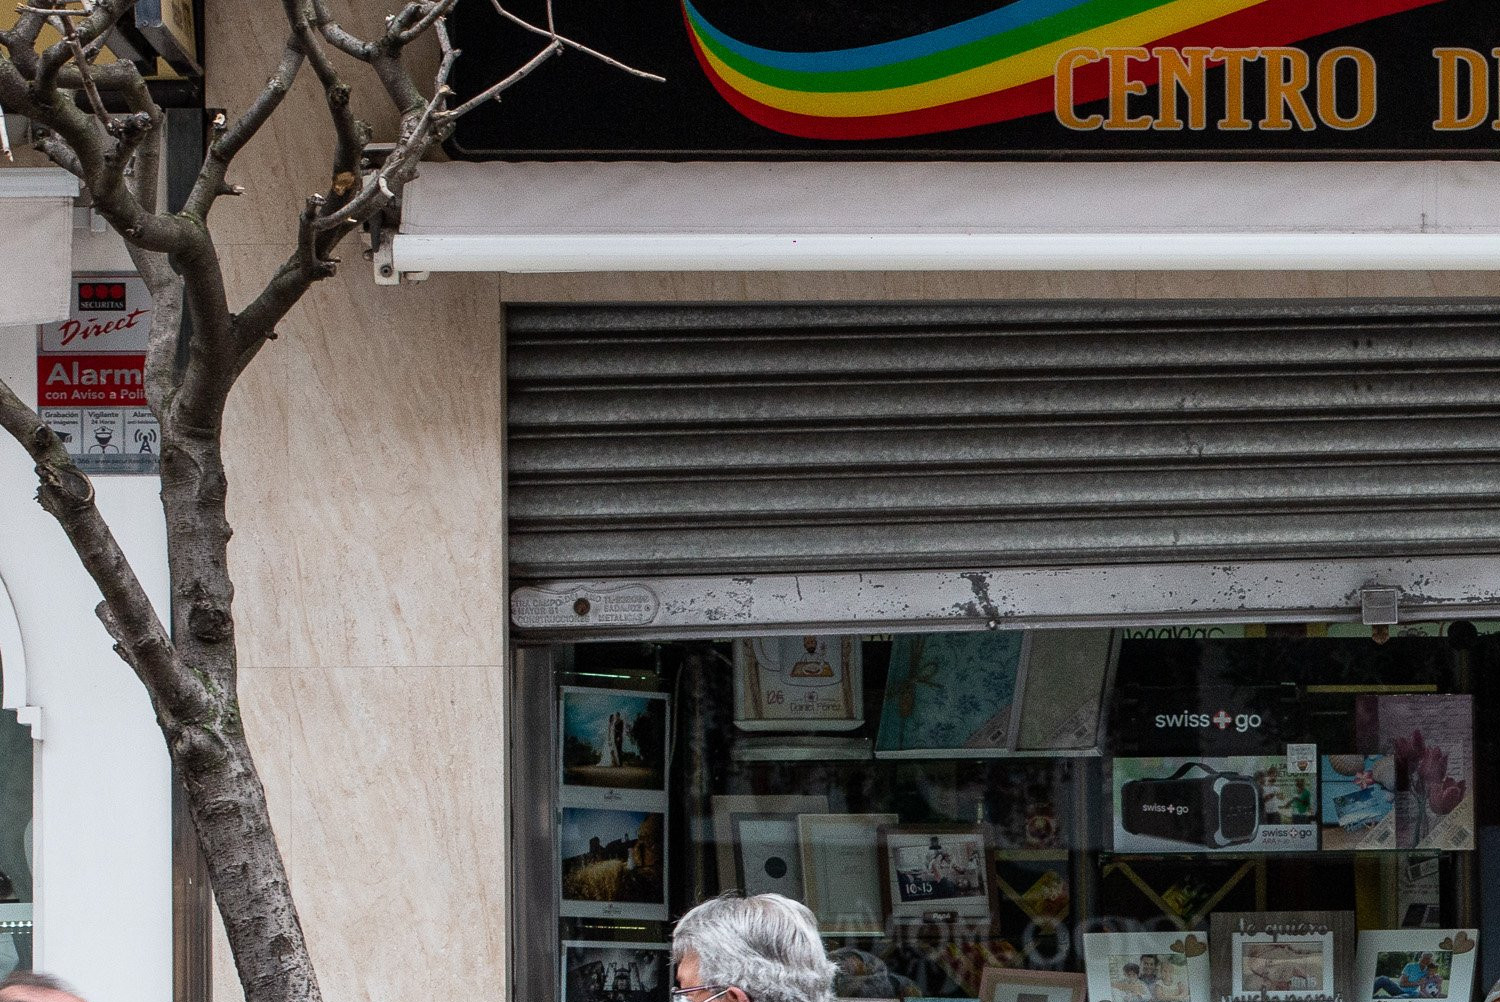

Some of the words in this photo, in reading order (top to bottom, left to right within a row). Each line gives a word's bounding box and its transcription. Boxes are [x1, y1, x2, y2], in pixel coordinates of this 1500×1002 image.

[1054, 46, 1378, 132] CENTRO
[80, 301, 124, 309] SECURITAS
[58, 307, 151, 346] Direct
[45, 362, 143, 386] Alarm
[45, 391, 67, 400] con
[71, 389, 106, 400] Aviso
[109, 391, 117, 400] a
[120, 388, 149, 400] Poli
[45, 410, 79, 418] Grabación
[88, 411, 119, 420] Vigilante
[1154, 709, 1211, 729] swiss
[1235, 713, 1262, 733] go
[1142, 802, 1166, 814] swiss
[1177, 803, 1190, 816] go
[1262, 828, 1288, 838] swiss
[1299, 829, 1313, 840] go
